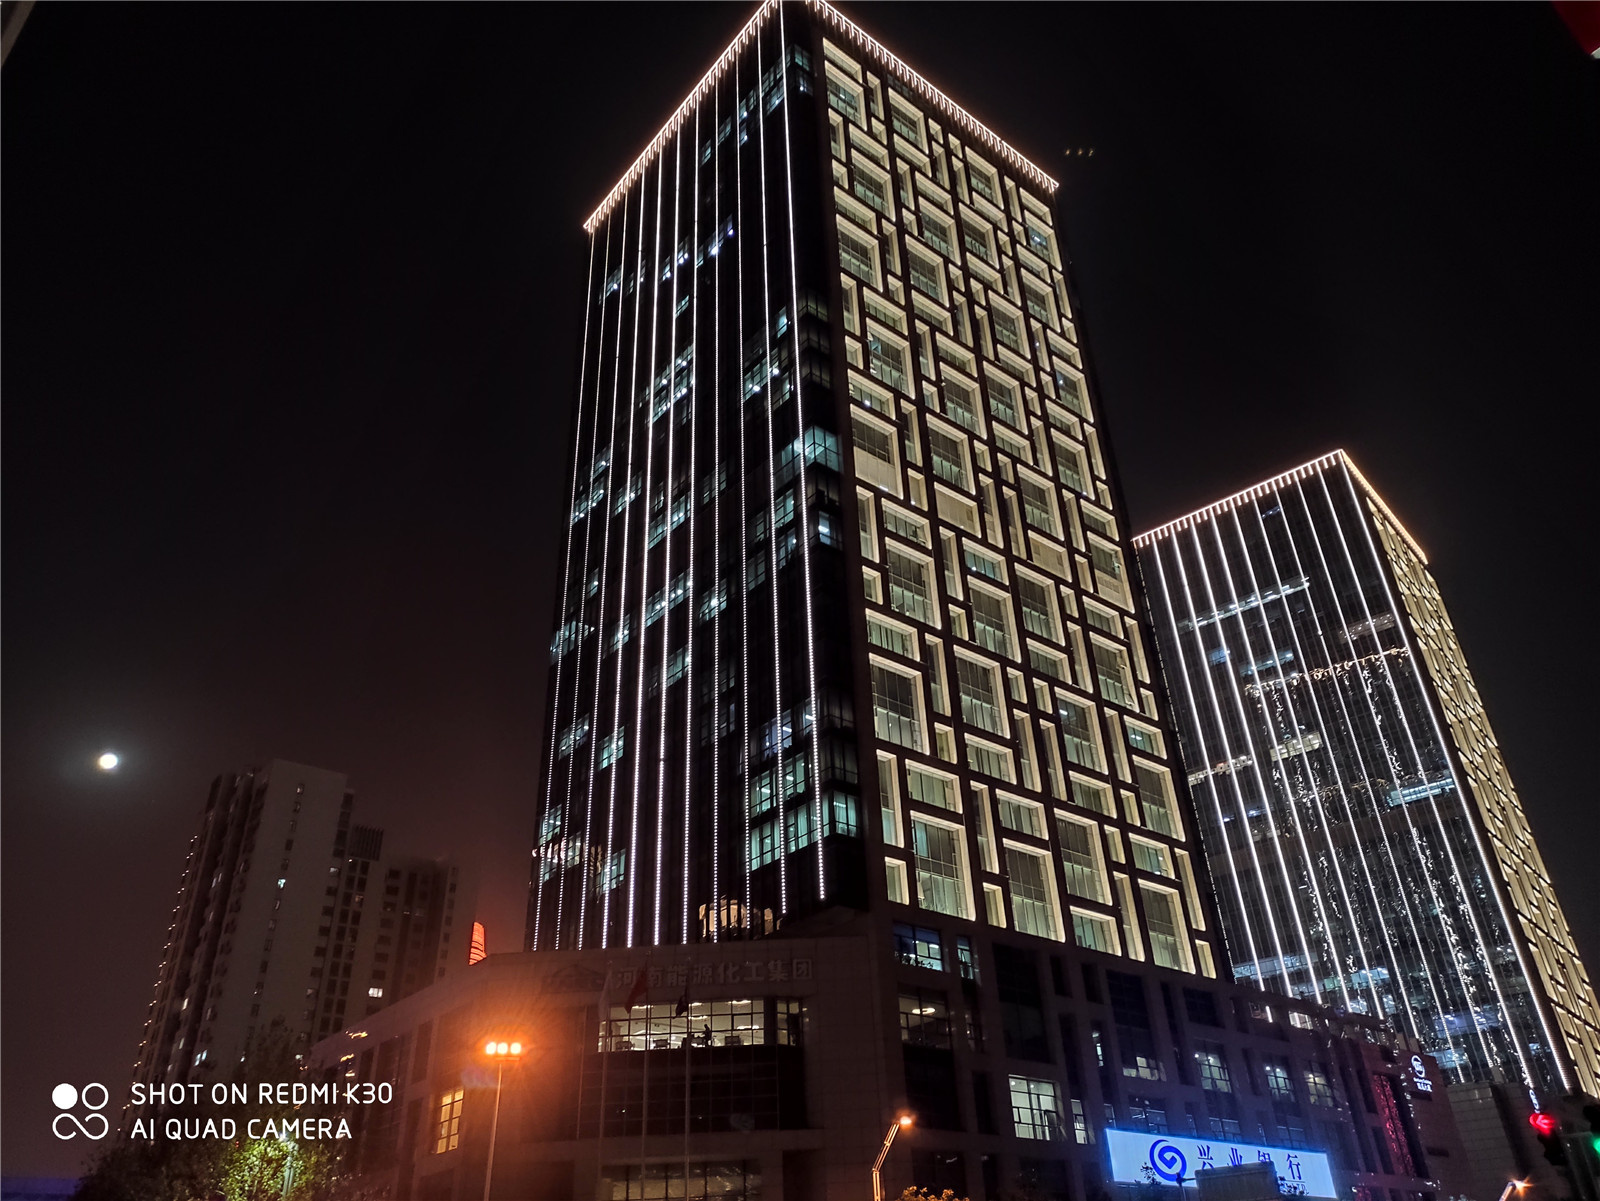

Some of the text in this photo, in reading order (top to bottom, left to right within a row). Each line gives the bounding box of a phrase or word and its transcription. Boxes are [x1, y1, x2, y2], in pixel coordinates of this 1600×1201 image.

[616, 959, 813, 988] 河南能源化工集团
